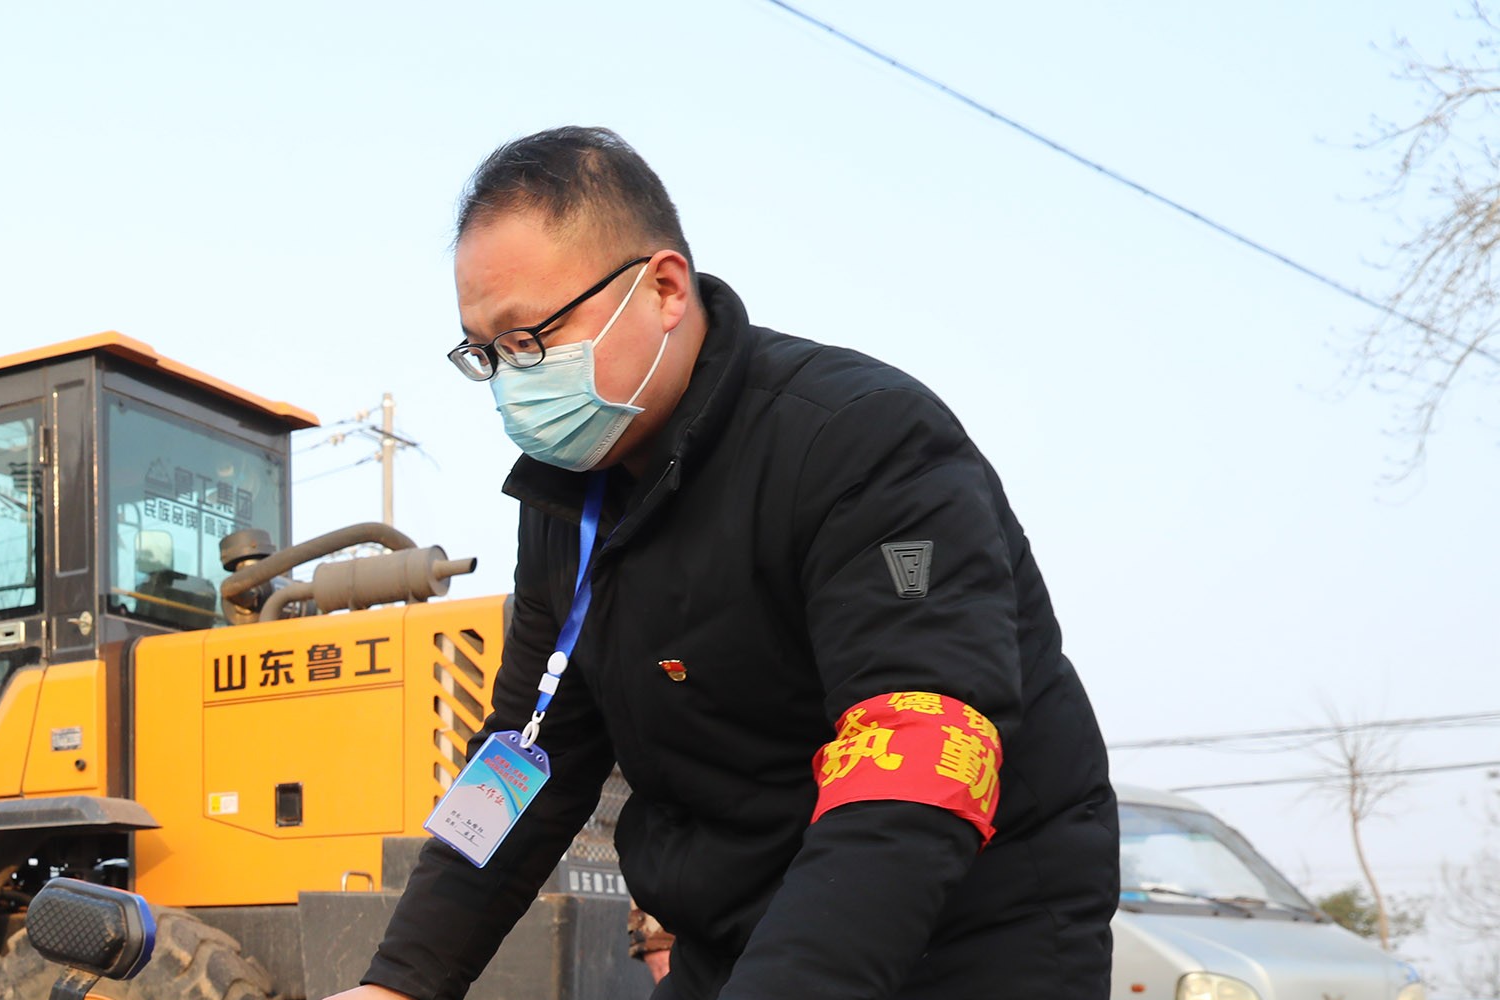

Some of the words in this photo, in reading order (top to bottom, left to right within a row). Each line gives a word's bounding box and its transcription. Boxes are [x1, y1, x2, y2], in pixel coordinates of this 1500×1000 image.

[213, 636, 392, 693] 山东鲁工
[821, 724, 999, 814] 执勤
